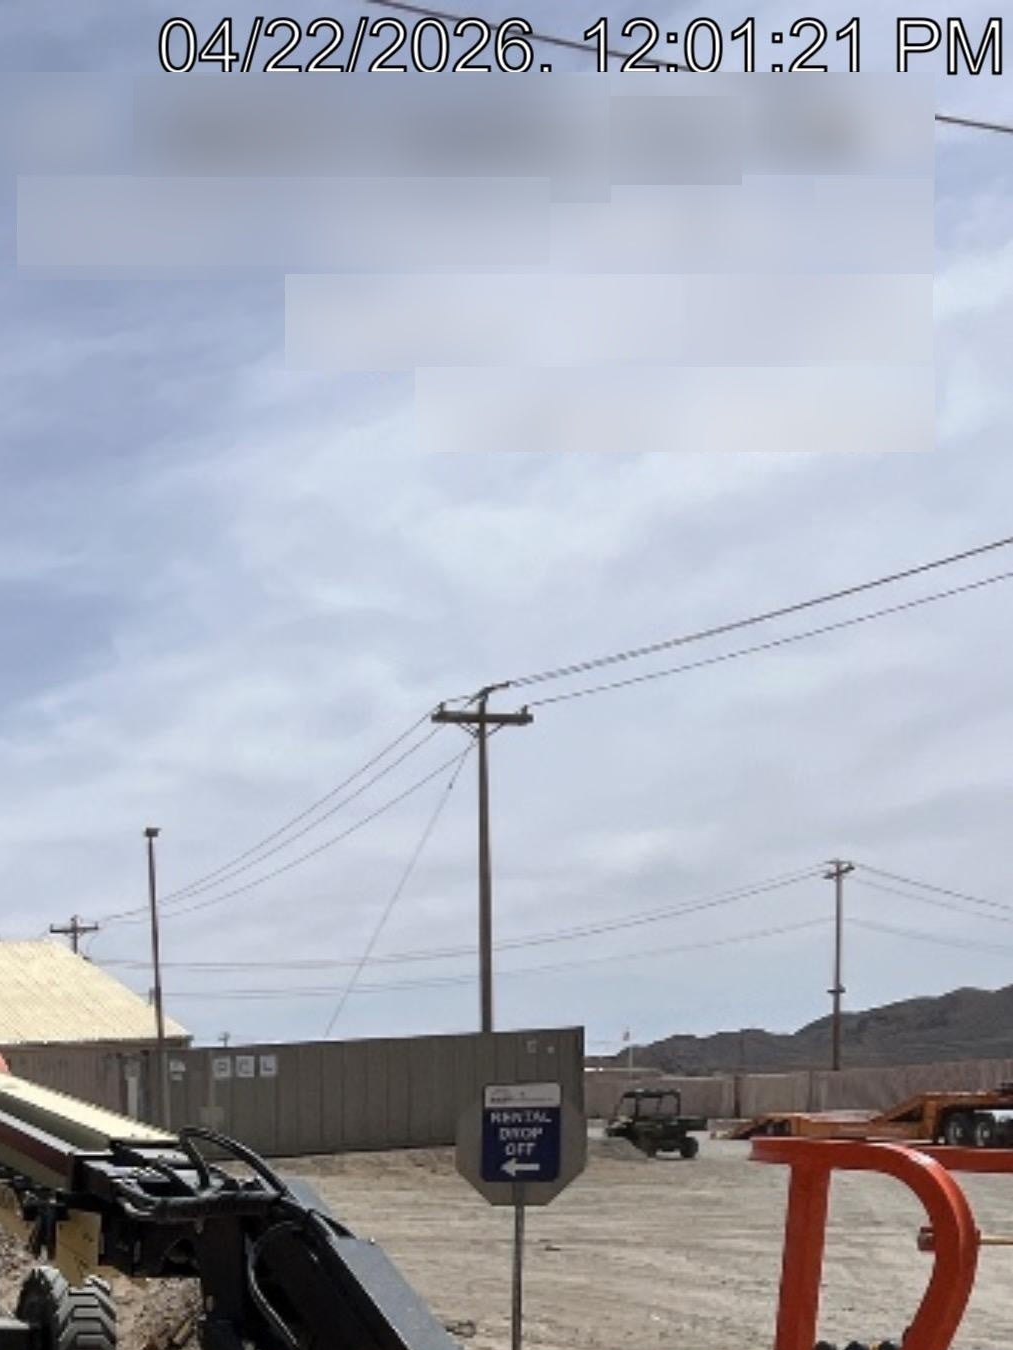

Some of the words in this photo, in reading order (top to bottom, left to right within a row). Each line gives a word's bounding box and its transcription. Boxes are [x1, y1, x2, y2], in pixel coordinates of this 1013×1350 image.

[490, 1111, 552, 1123] RENTAL
[499, 1127, 543, 1140] DROP
[505, 1142, 537, 1156] OFF
